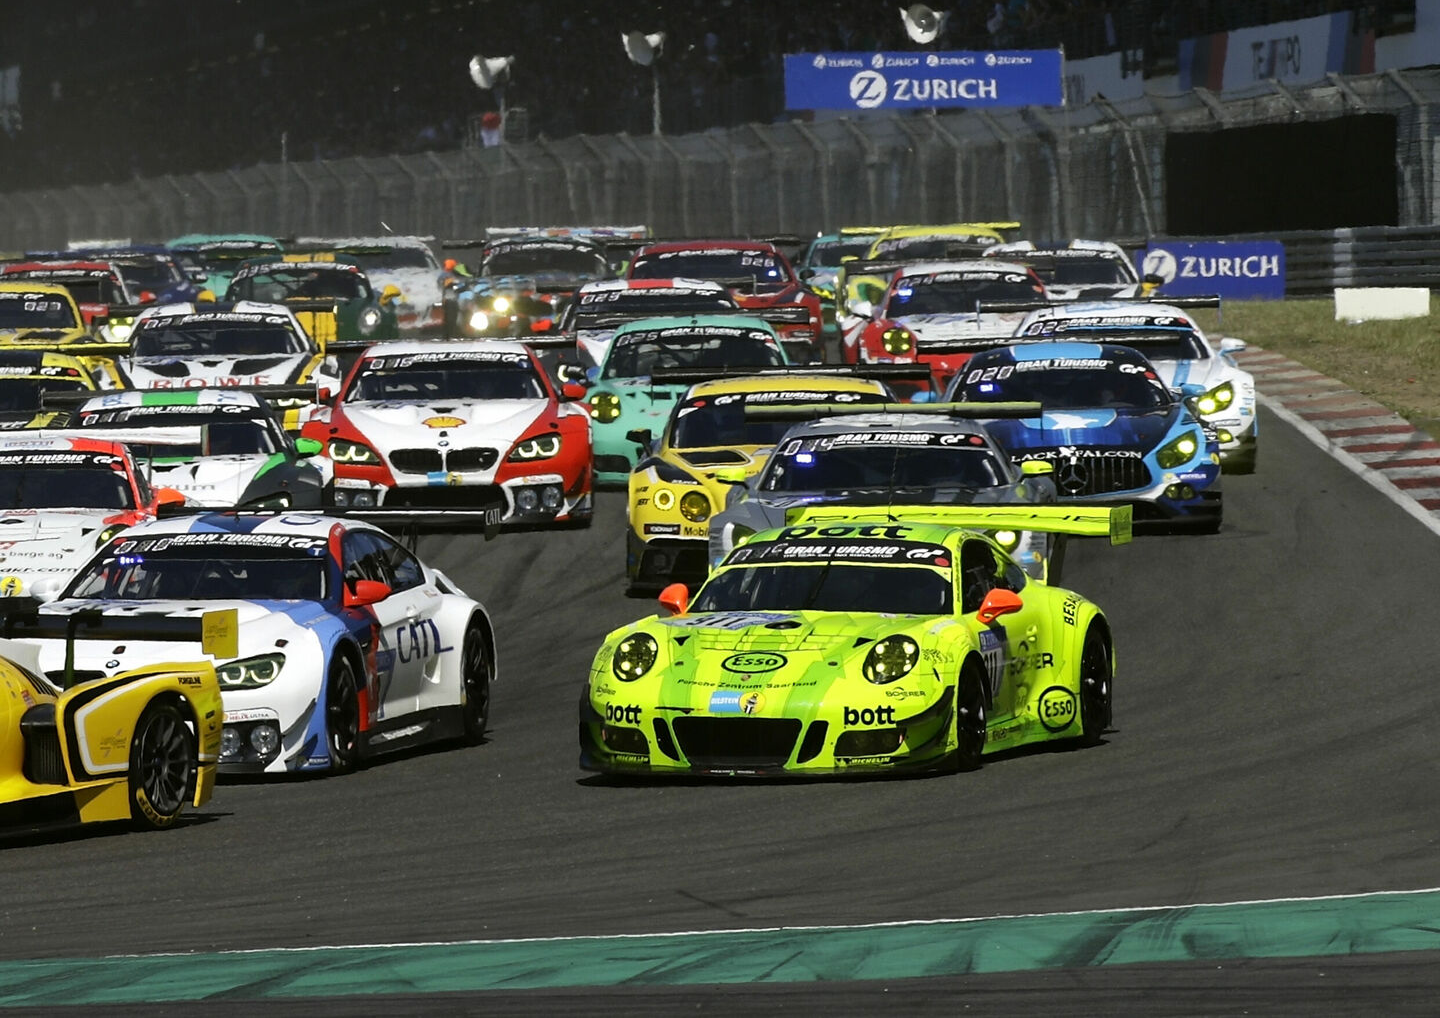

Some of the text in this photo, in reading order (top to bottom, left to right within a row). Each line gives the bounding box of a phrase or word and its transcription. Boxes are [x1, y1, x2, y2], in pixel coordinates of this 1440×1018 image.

[894, 79, 997, 100] ZURICH
[1181, 255, 1279, 277] ZURICH
[1016, 360, 1050, 369] GRAN
[1054, 359, 1108, 368] TURISMO
[149, 374, 272, 387] ROWE
[746, 392, 778, 400] GRAN
[780, 392, 828, 400] TURISMO
[26, 454, 86, 462] TURISMO
[1076, 449, 1142, 459] FALCON
[485, 508, 503, 525] CATL
[173, 534, 213, 542] GRAN
[220, 534, 289, 544] TURISMO
[777, 525, 913, 541] bott
[10, 551, 44, 560] barge
[48, 552, 64, 560] ag
[785, 546, 823, 555] GRAN
[827, 546, 897, 554] TURISMO
[396, 619, 454, 663] CATL
[677, 678, 817, 689] Porsche Zentrum Saarland
[606, 701, 642, 725] bott
[844, 705, 896, 725] bott
